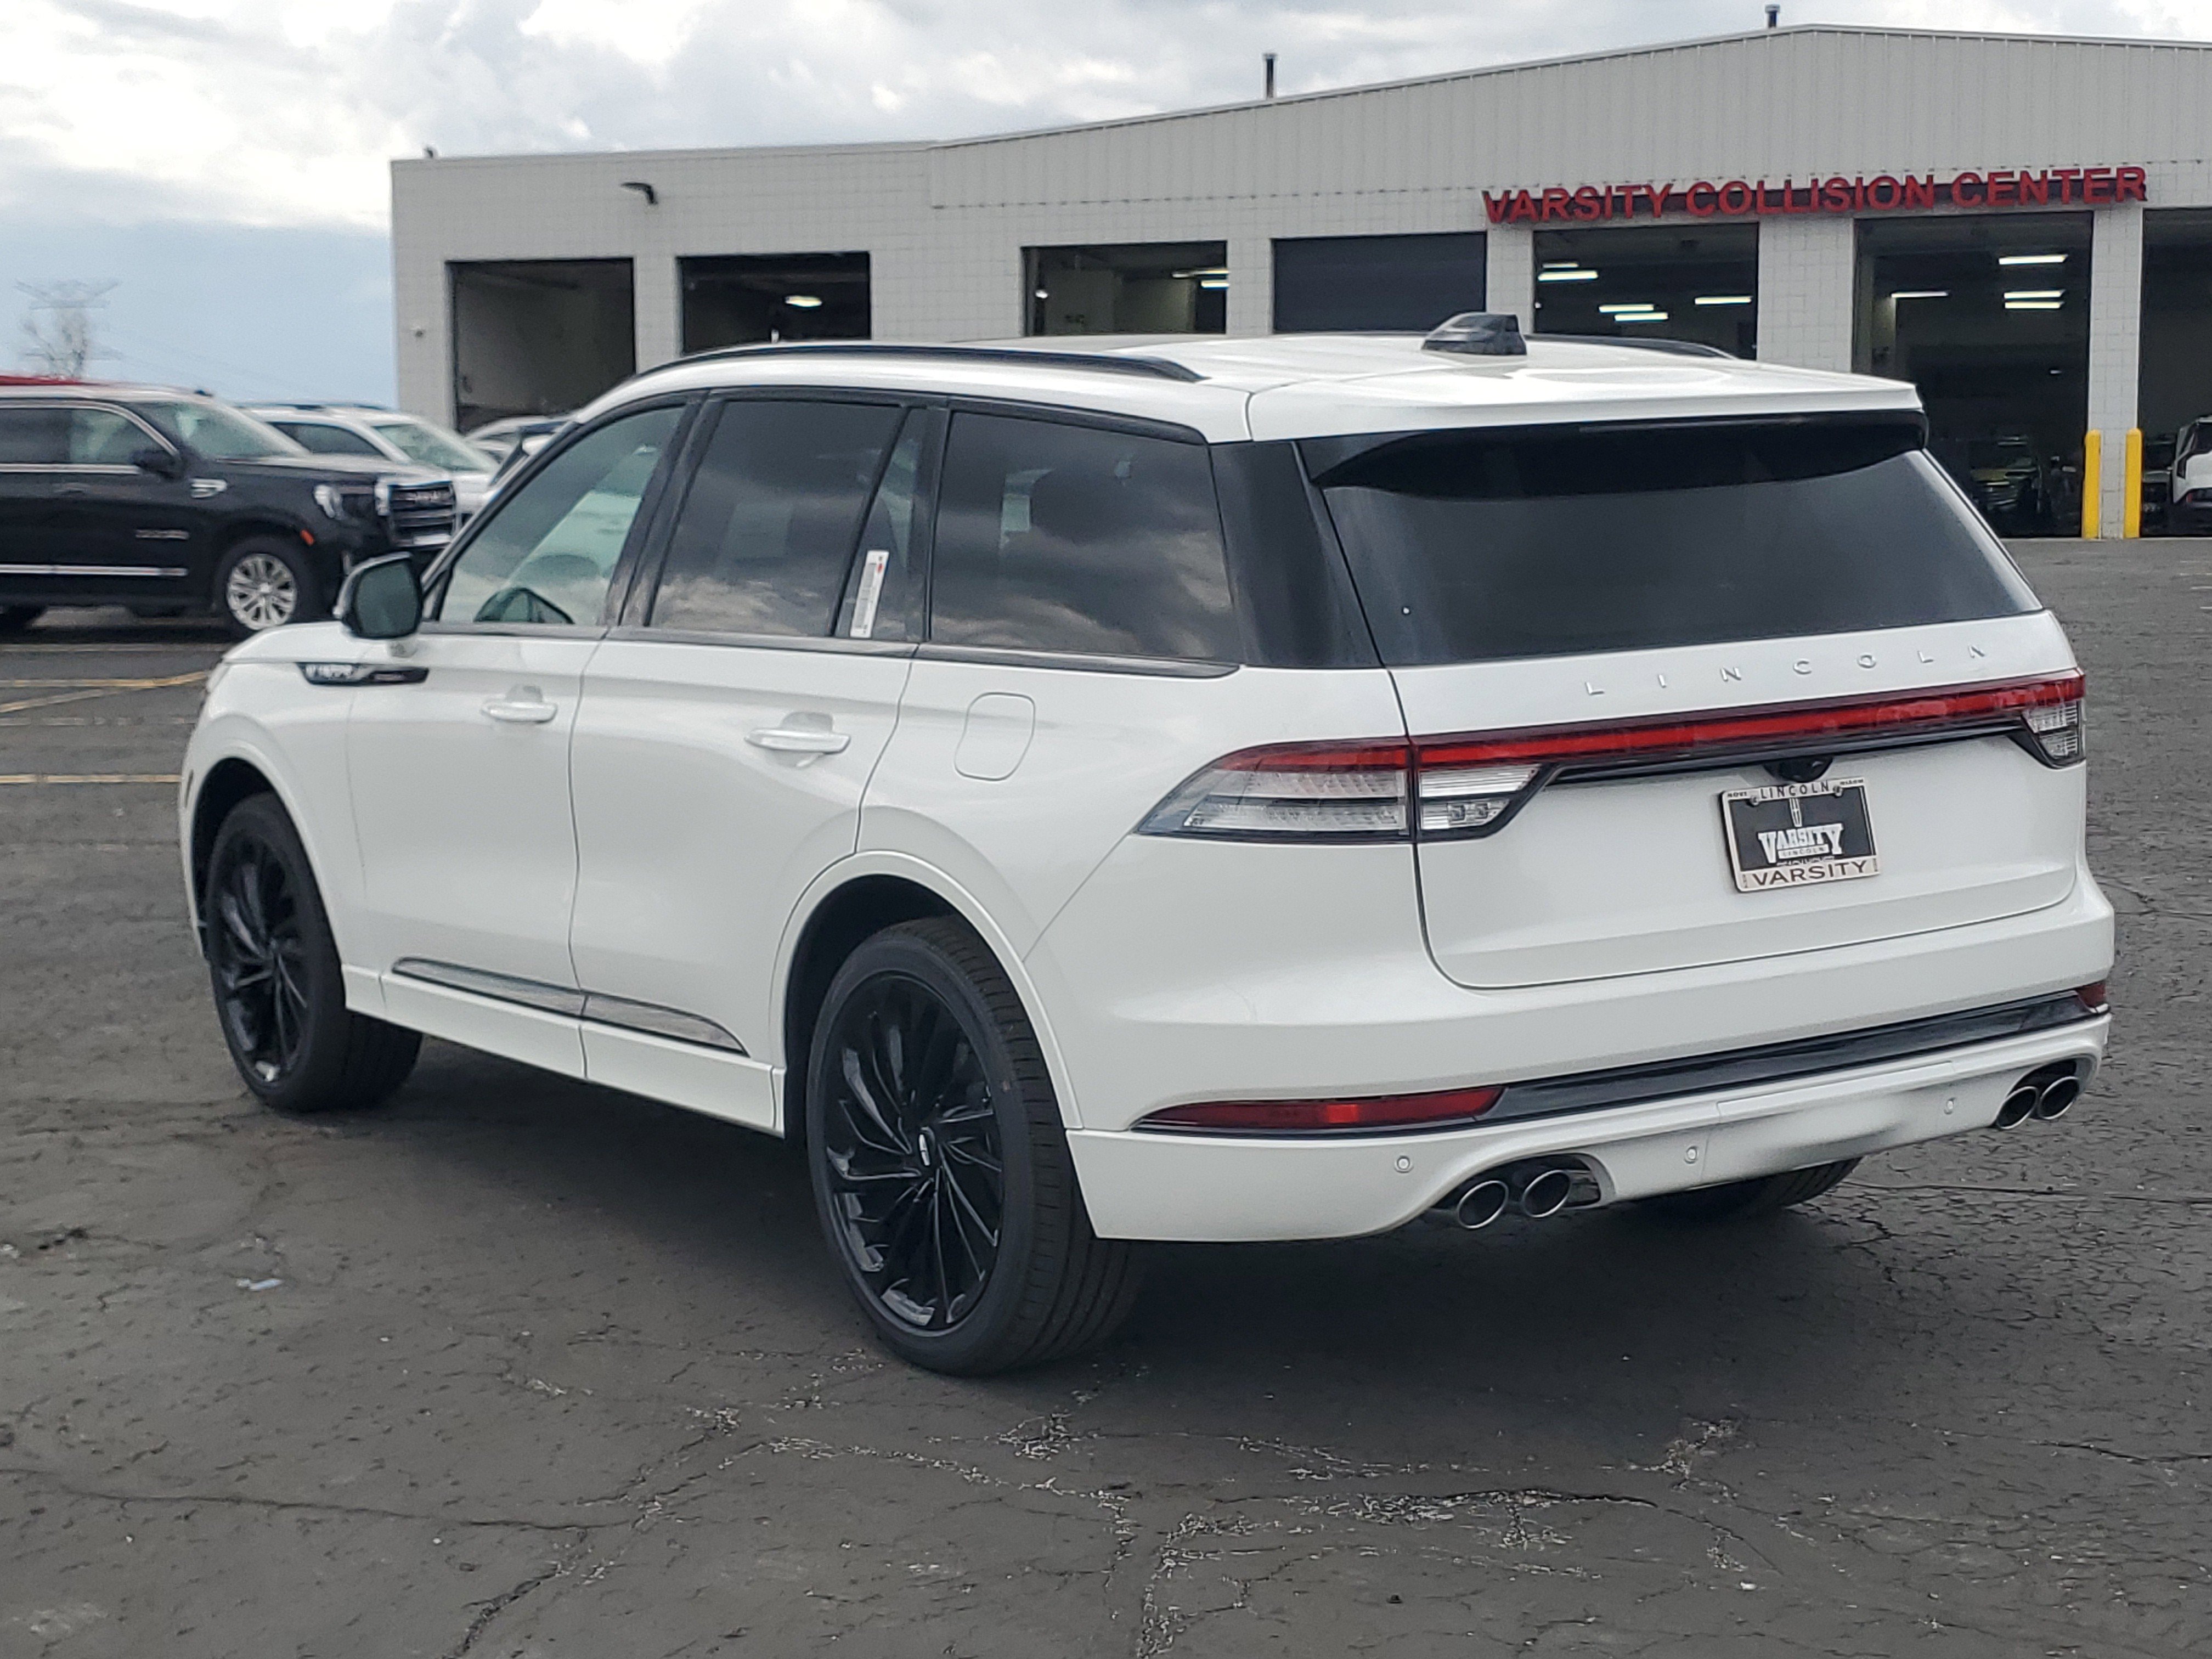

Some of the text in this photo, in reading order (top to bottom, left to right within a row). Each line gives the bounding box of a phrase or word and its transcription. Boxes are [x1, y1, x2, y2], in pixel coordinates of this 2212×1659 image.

[1481, 166, 2147, 224] VARSITY COLLISION CENTER
[1584, 644, 1986, 696] LINCOLN
[1760, 781, 1830, 799] LINCOLN
[1757, 823, 1845, 864] VARSITY
[1782, 847, 1825, 857] LINCOLN
[1752, 860, 1867, 886] VARSITY
